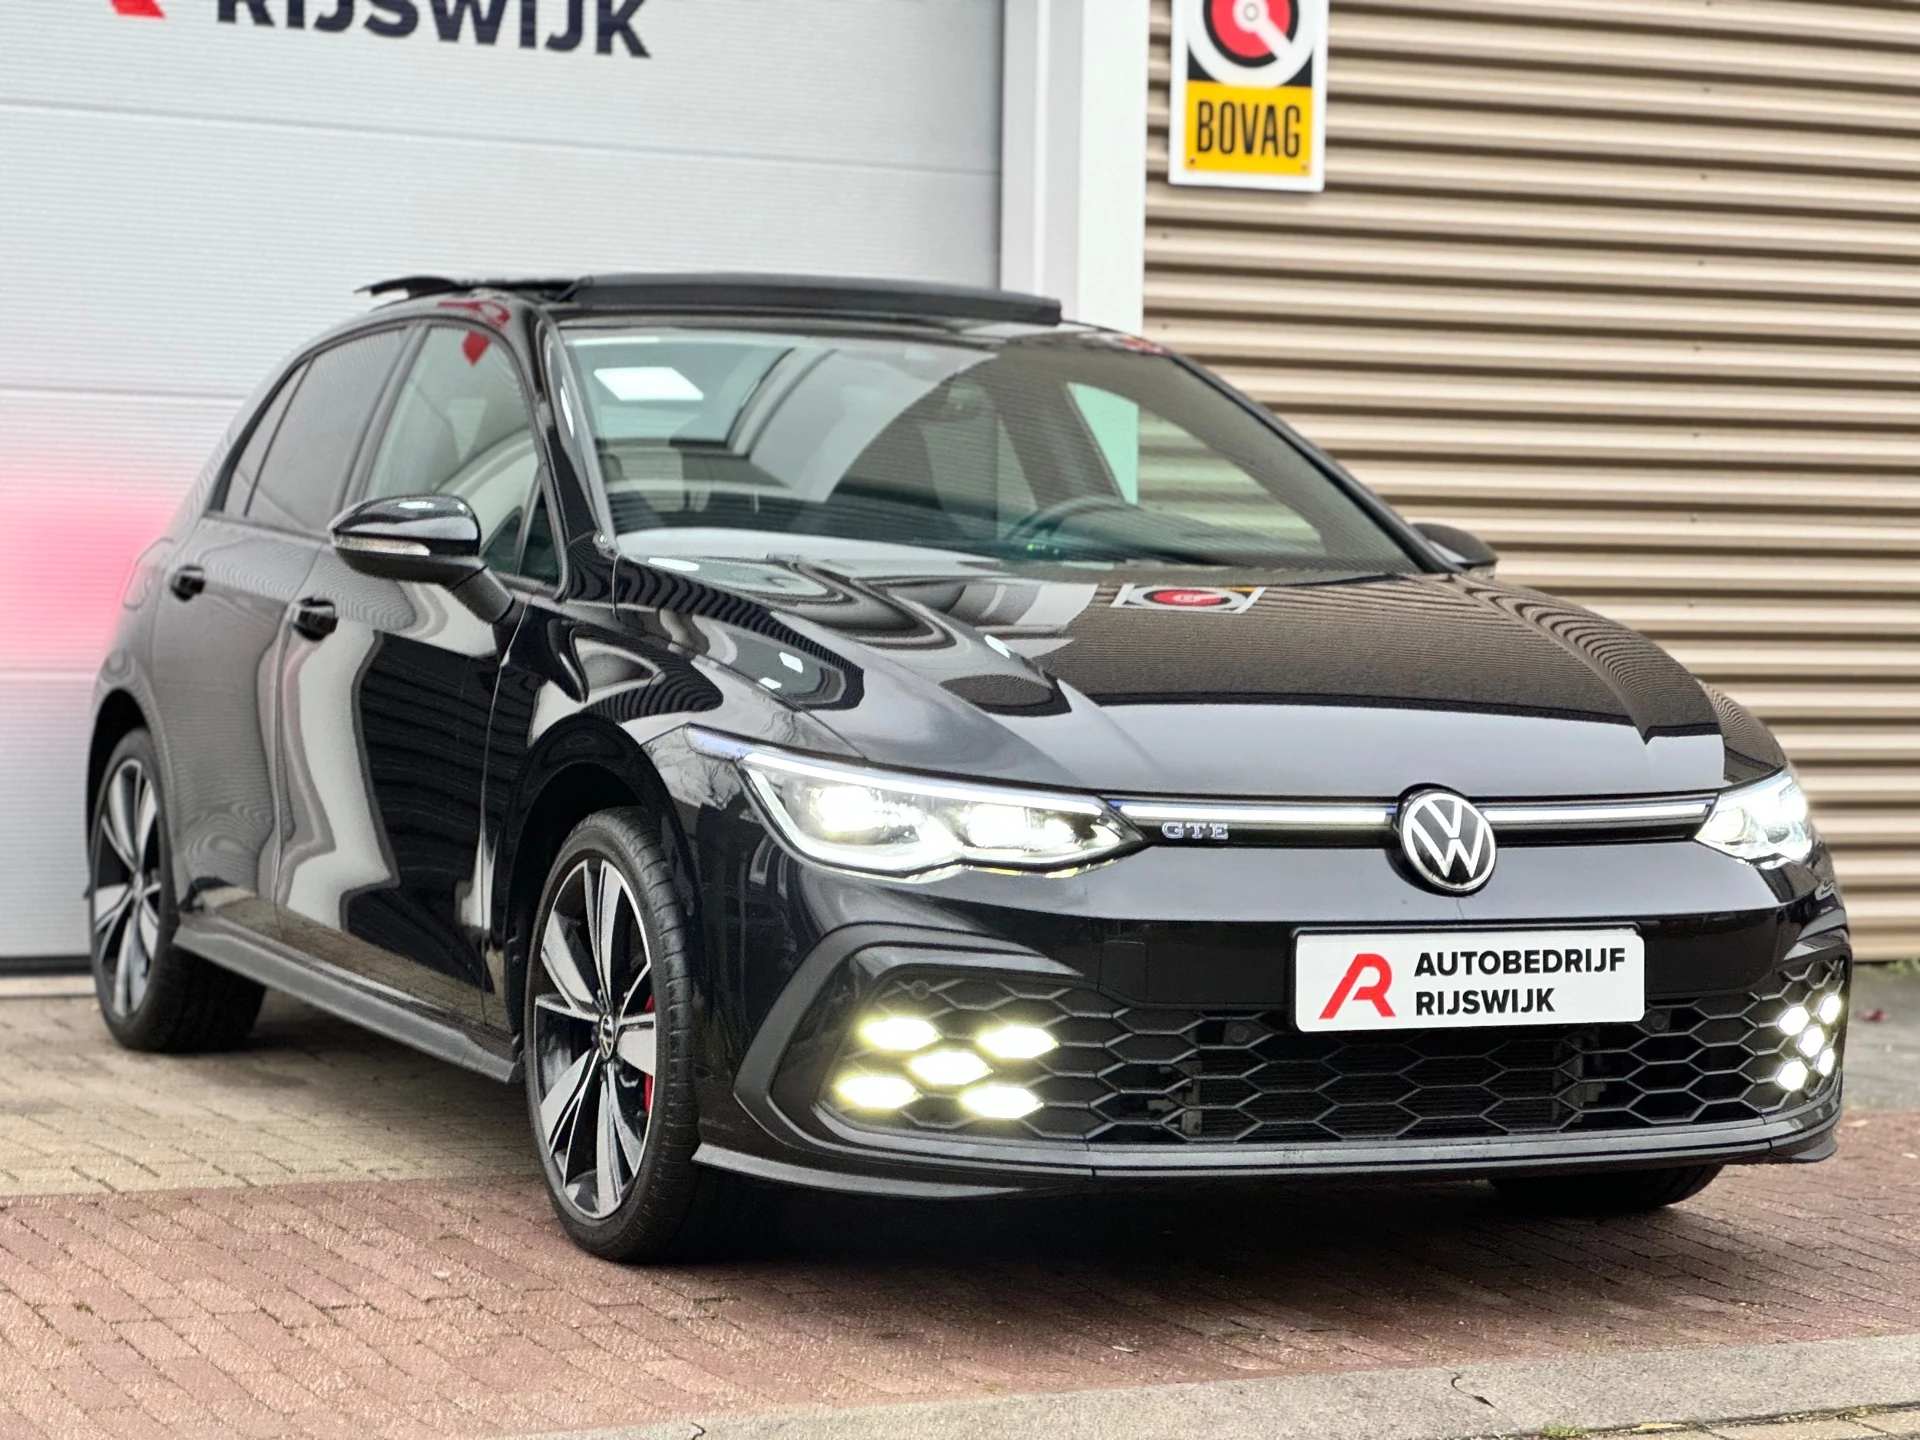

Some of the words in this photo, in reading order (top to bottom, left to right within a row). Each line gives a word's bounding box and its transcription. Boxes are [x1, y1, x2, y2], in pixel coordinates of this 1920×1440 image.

[1197, 100, 1300, 158] BOVAG
[1161, 822, 1229, 840] GTE
[1414, 948, 1625, 977] AUTOBEDRIJF
[1415, 987, 1556, 1016] RIJSWIJK
